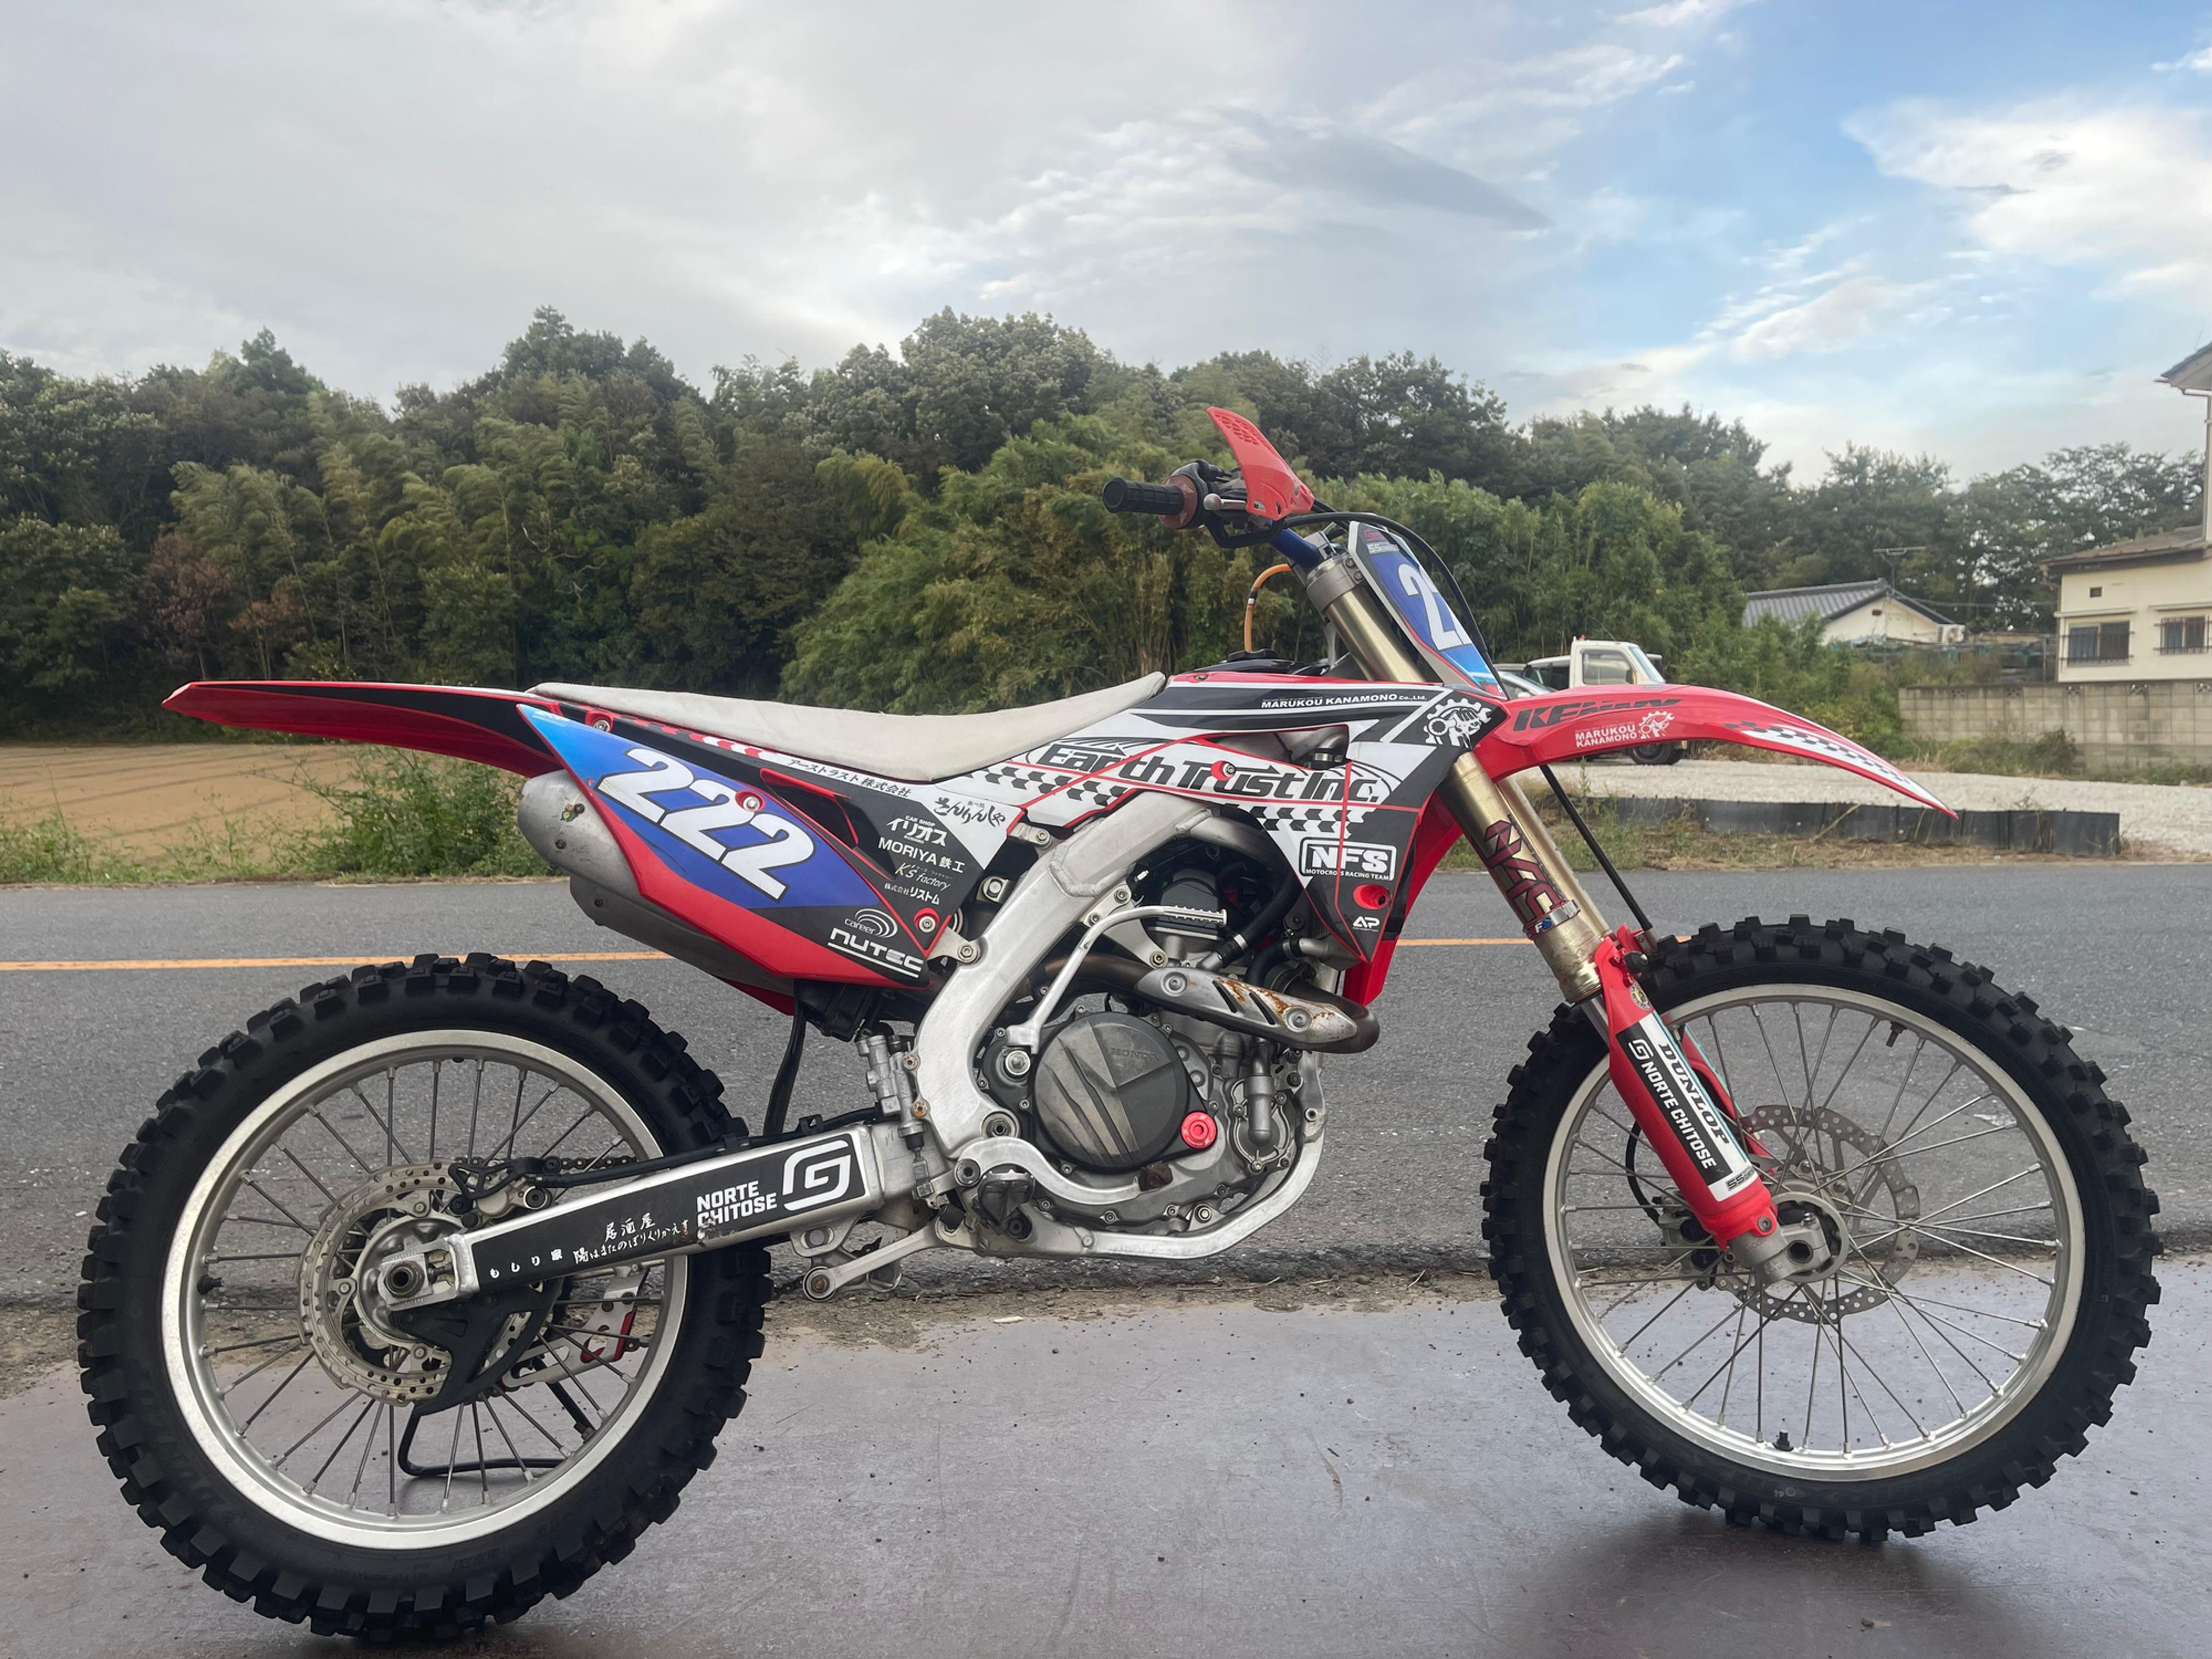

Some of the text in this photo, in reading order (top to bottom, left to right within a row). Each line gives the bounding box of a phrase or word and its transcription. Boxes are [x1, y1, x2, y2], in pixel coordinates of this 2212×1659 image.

[1261, 699, 1323, 708] MARUKOU
[1325, 693, 1398, 705] KANAMONO
[1575, 724, 1635, 741] MARUKOU
[1576, 732, 1638, 748] KANAMONO
[594, 746, 815, 903] 222
[887, 817, 948, 847] イリオス
[878, 837, 936, 866] MORIYA
[1309, 846, 1389, 873] NFS
[916, 872, 951, 891] factory
[844, 918, 876, 934] career
[1353, 916, 1380, 929] AP
[1659, 1043, 1730, 1144] DUNLOP
[1641, 1061, 1679, 1109] NORTE
[1671, 1108, 1717, 1169] CHITOSE
[696, 1180, 760, 1212] NORTE
[697, 1192, 777, 1228] CHITOSE
[605, 1212, 656, 1243] 居酒屋
